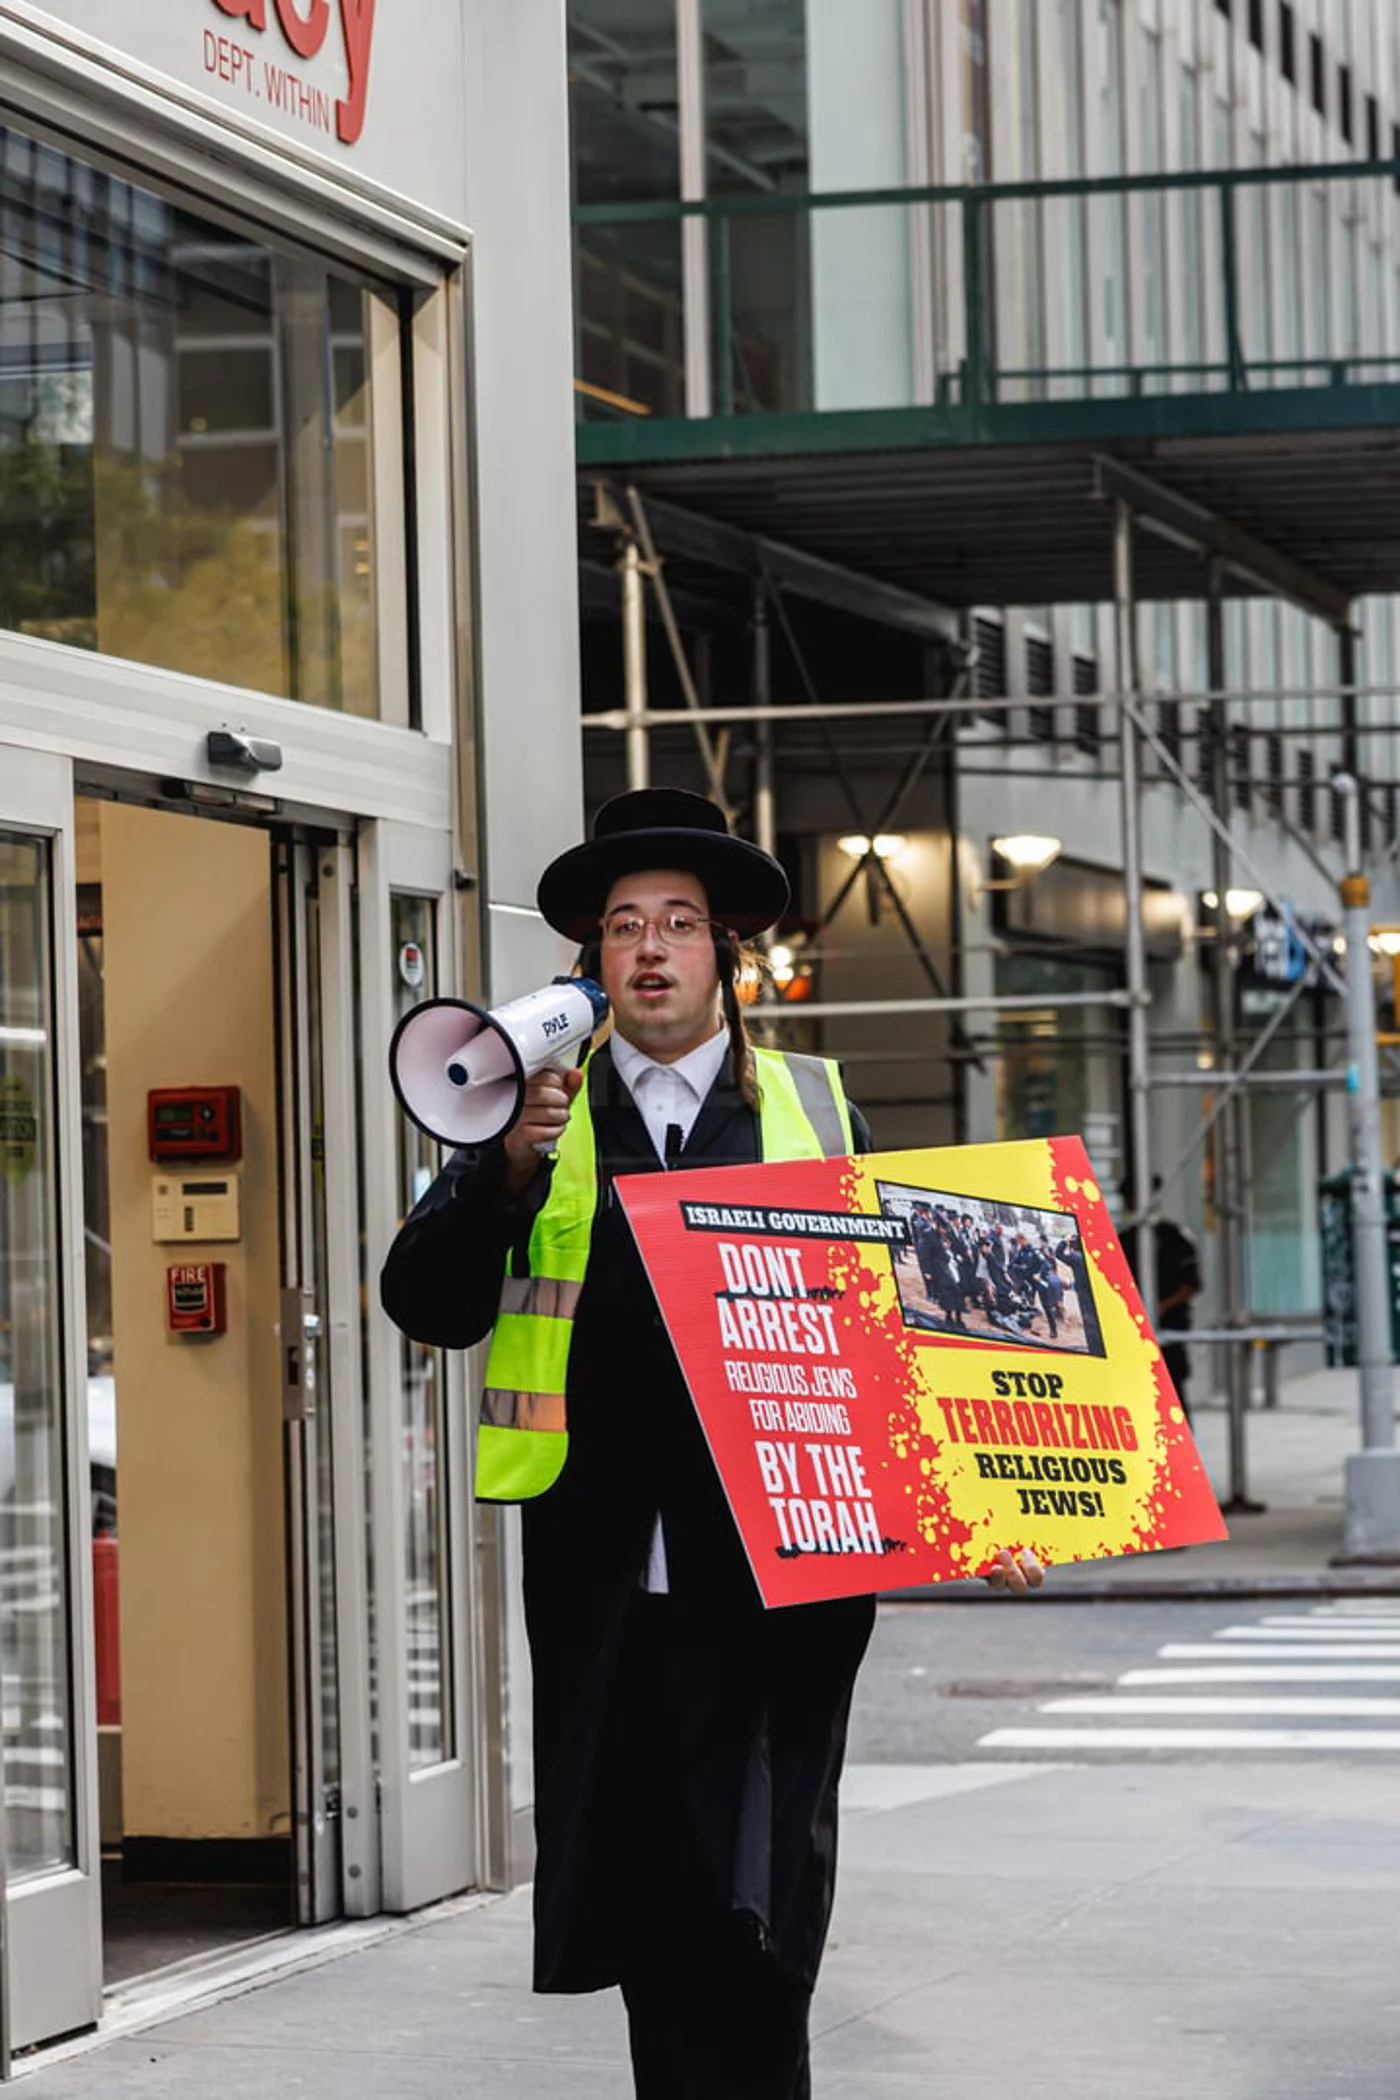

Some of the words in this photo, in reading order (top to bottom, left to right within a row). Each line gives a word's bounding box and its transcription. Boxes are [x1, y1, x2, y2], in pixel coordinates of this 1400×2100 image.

[204, 29, 260, 97] DEPT.
[264, 60, 329, 134] WITHIN
[542, 1013, 569, 1037] PYLE
[685, 1206, 766, 1229] ISRAELI
[768, 1211, 905, 1239] GOVERNMENT
[170, 1267, 206, 1281] FIRE
[718, 1242, 807, 1298] DONT
[716, 1297, 840, 1355] ARREST
[724, 1360, 809, 1396] RELIGIOUS
[811, 1365, 857, 1399] JEWS
[991, 1370, 1064, 1399] STOP
[749, 1399, 786, 1431] FOR
[786, 1401, 852, 1435] ABIDING
[936, 1397, 1140, 1451] TERRORIZING
[754, 1440, 801, 1495] BY
[805, 1443, 872, 1498] THE
[974, 1453, 1127, 1485] RELIGIOUS
[1016, 1489, 1106, 1518] JEWS!
[768, 1497, 884, 1554] TORAH
